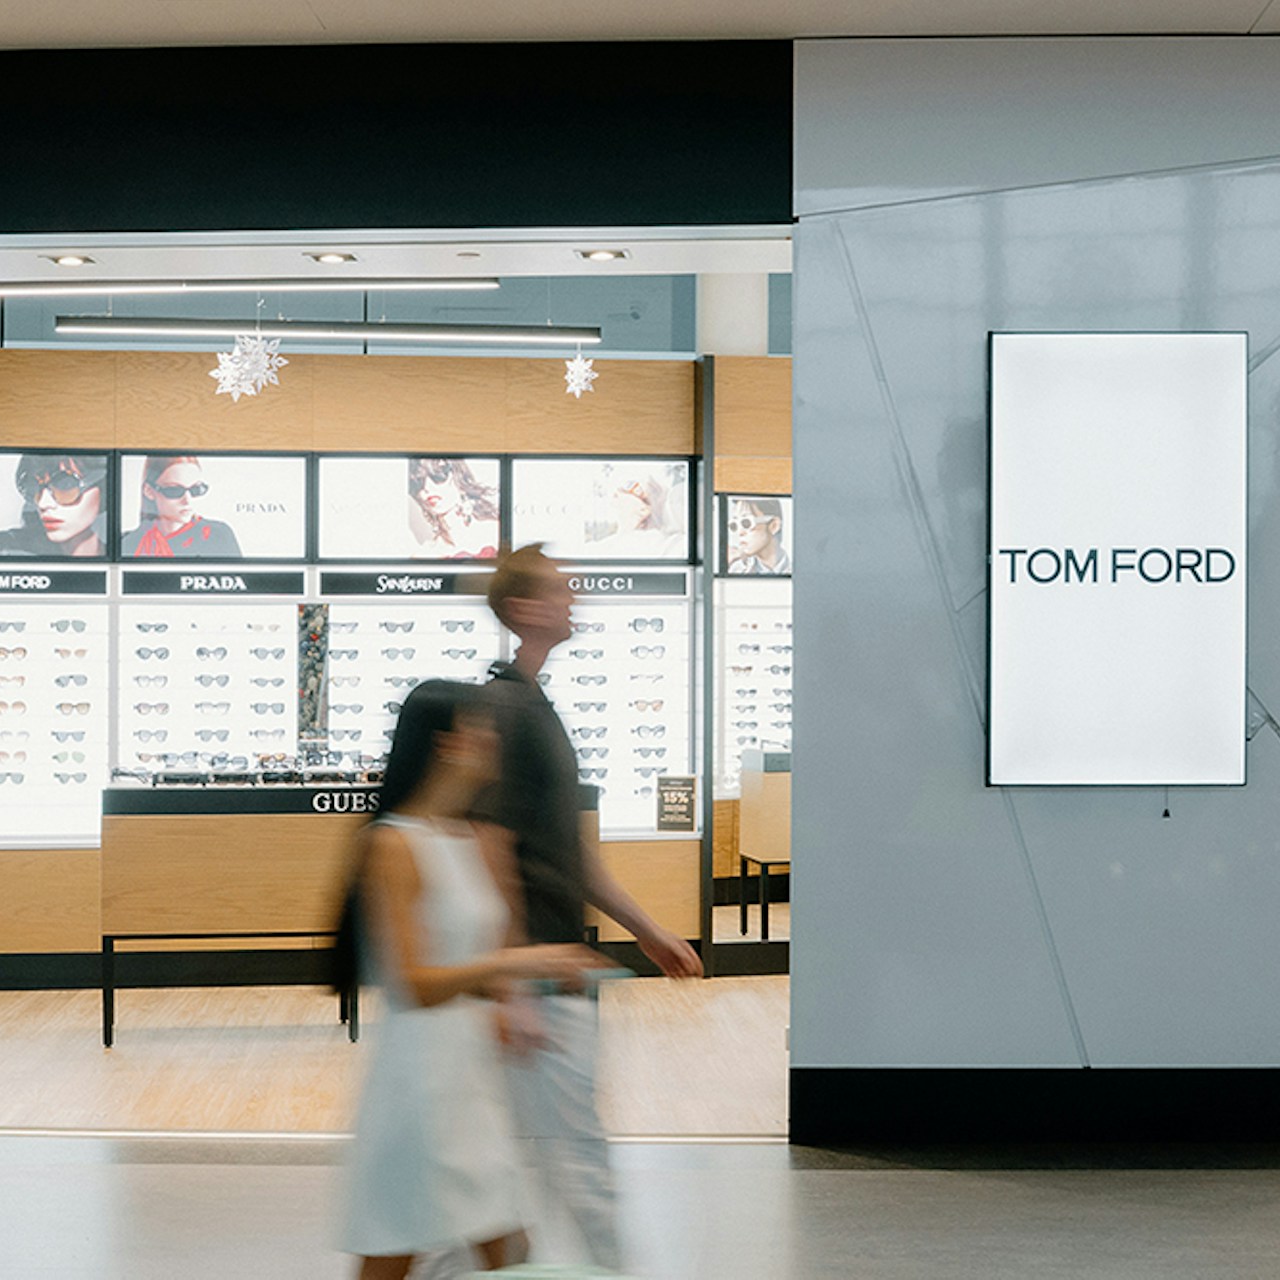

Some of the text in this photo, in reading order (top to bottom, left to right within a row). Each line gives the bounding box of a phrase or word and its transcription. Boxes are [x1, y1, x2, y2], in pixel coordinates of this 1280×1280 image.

[235, 503, 286, 513] PRADA
[999, 548, 1236, 584] TOM FORD
[11, 575, 51, 589] FORD
[180, 575, 247, 590] PRADA
[567, 577, 634, 591] GUCCI
[312, 792, 381, 812] GUES
